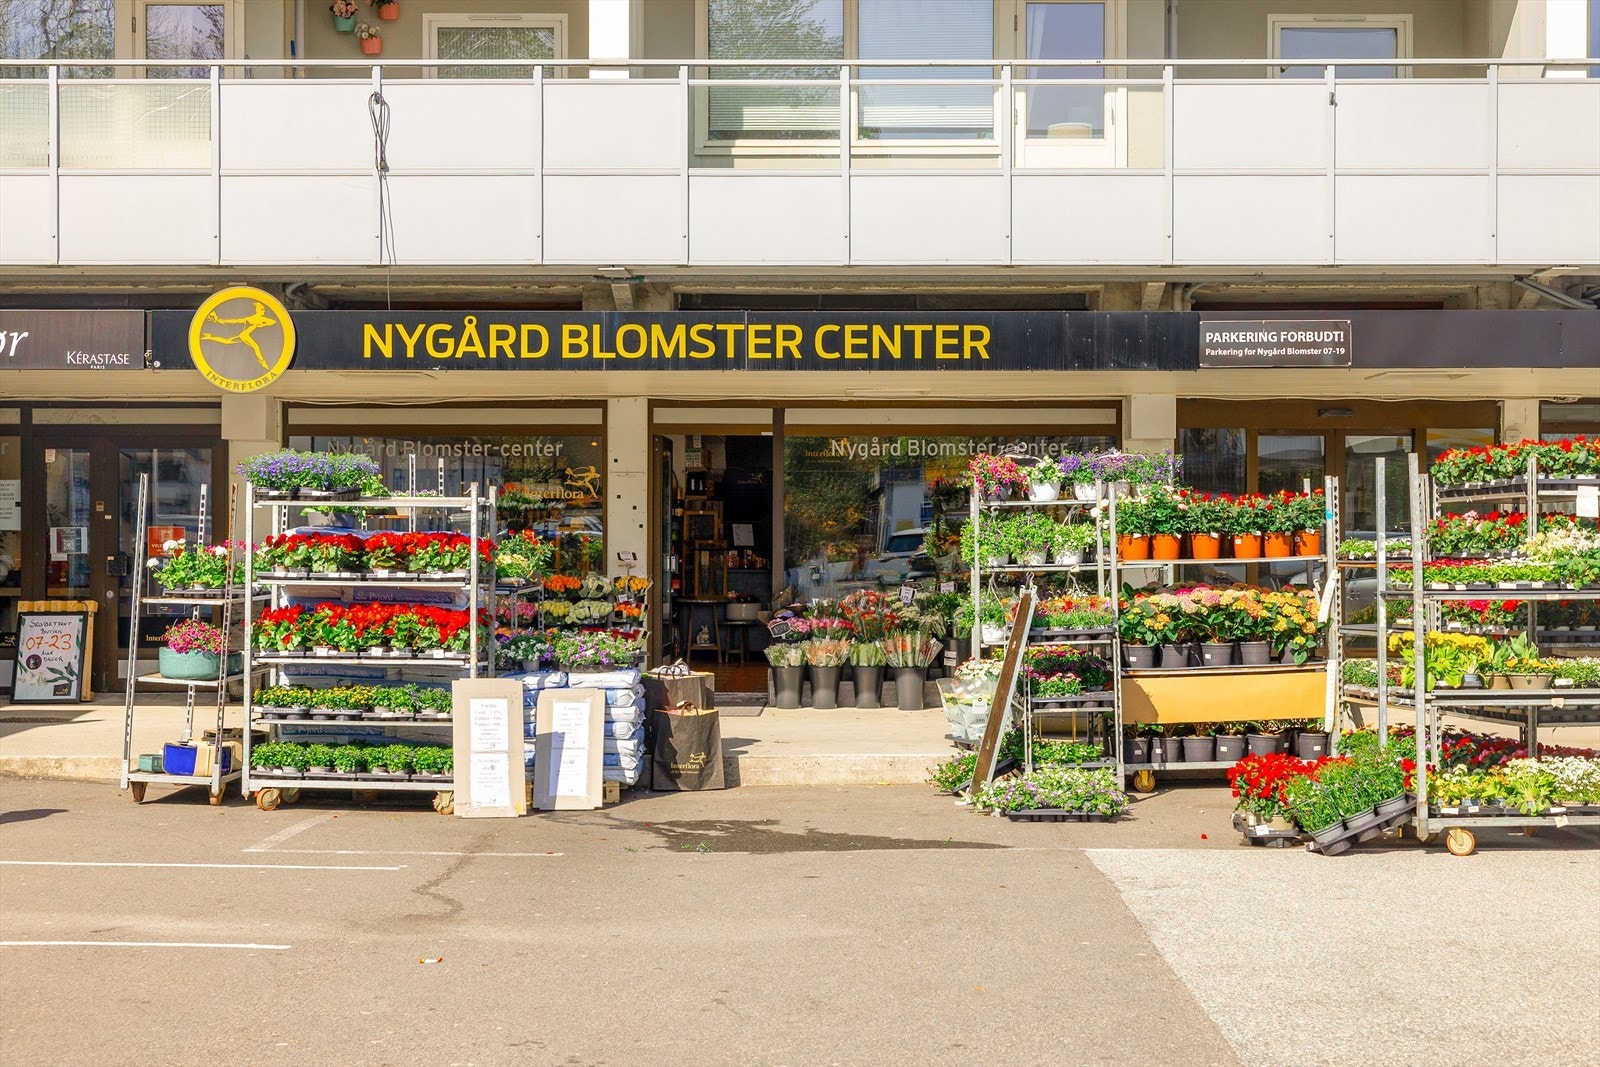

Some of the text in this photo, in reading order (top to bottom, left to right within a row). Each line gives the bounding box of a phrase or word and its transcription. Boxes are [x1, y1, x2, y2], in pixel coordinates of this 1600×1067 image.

[363, 315, 991, 359] NYGÅRD BLOMSTER CENTER
[1205, 331, 1344, 343] PARKERING FORBUDT!
[66, 351, 130, 365] KÉRASTASE
[1205, 348, 1243, 357] Parkering
[1257, 347, 1286, 357] Nygård
[1287, 347, 1322, 355] Blomster
[1323, 347, 1345, 355] 07-19
[206, 371, 278, 390] INTERFLORA
[403, 440, 564, 457] Blomster-center
[831, 437, 901, 460] Nygård
[25, 633, 72, 651] 07-23
